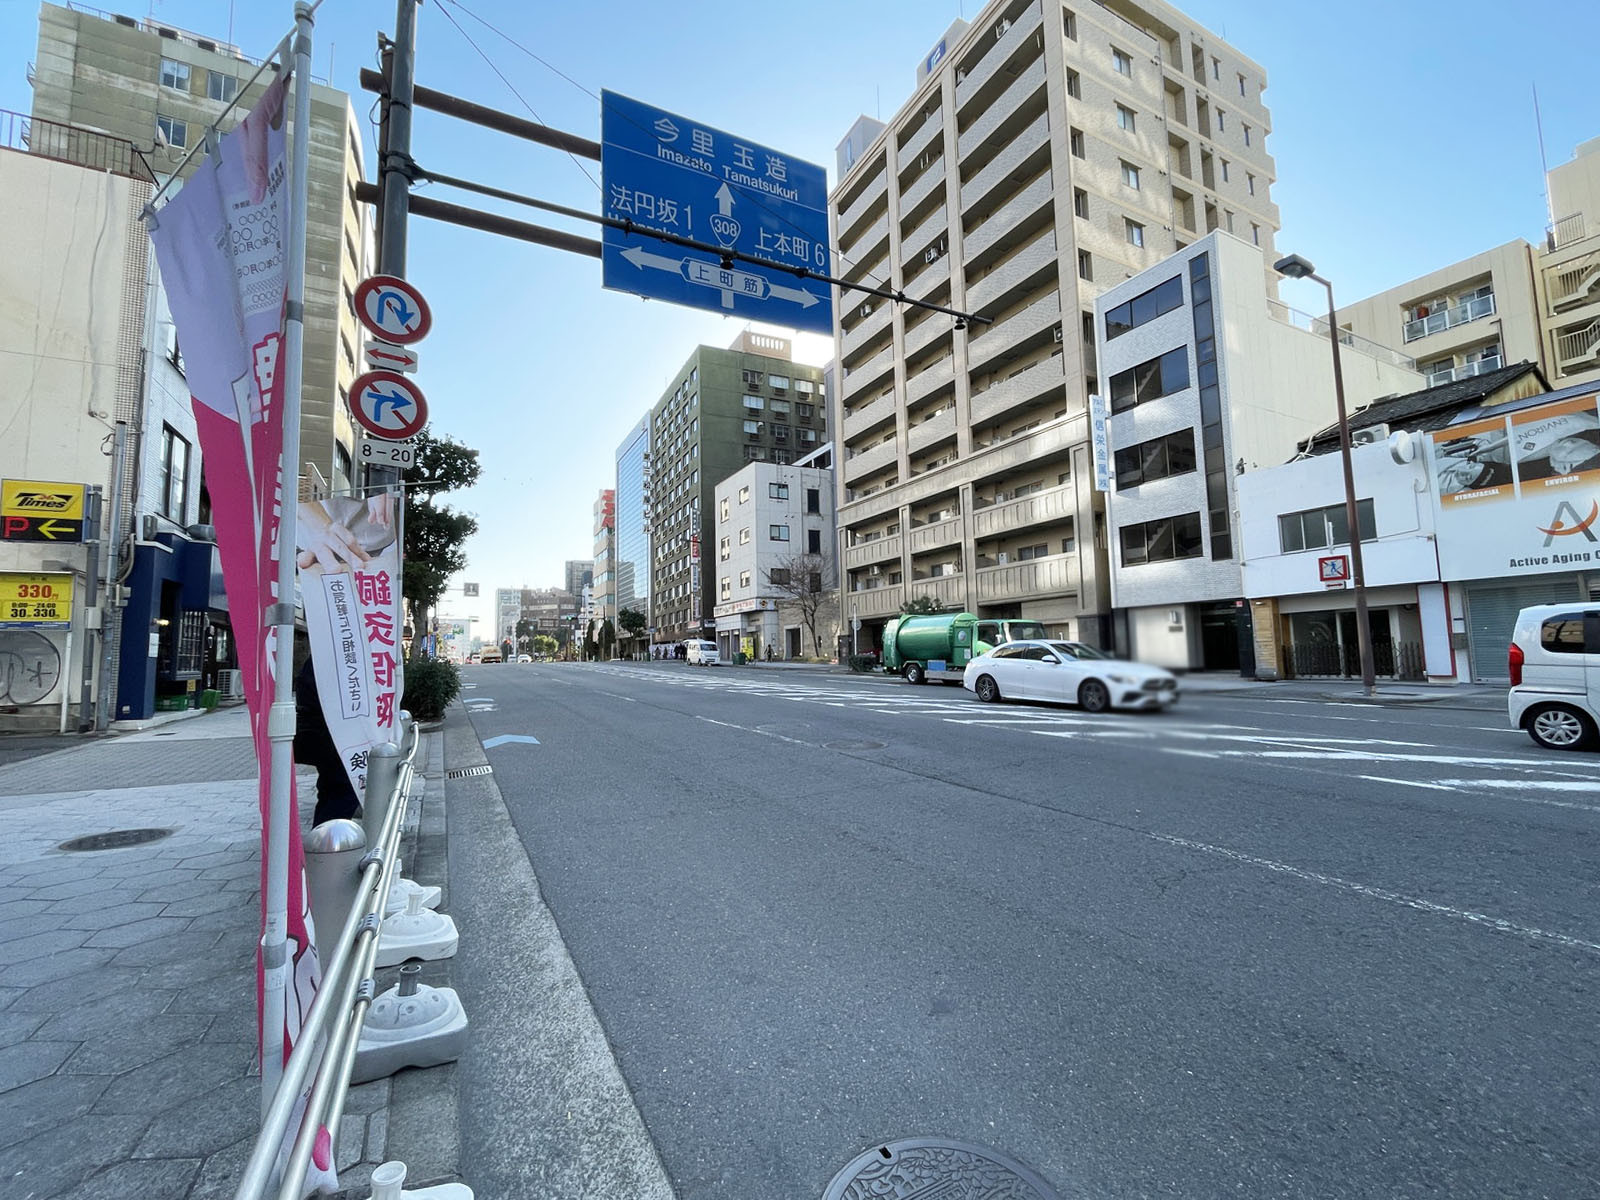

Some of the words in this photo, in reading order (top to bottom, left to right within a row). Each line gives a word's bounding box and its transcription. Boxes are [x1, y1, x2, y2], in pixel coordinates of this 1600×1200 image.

[654, 118, 715, 158] 今里
[733, 143, 788, 182] 玉造
[657, 144, 712, 173] Imazato
[722, 165, 799, 201] Tamatsukuri
[714, 218, 737, 237] 308
[695, 264, 759, 294] 上町筋
[1544, 475, 1581, 487] ENVIRON
[15, 492, 73, 508] Times
[3, 516, 30, 538] P
[1510, 556, 1549, 568] Active
[1552, 552, 1591, 564] Aging
